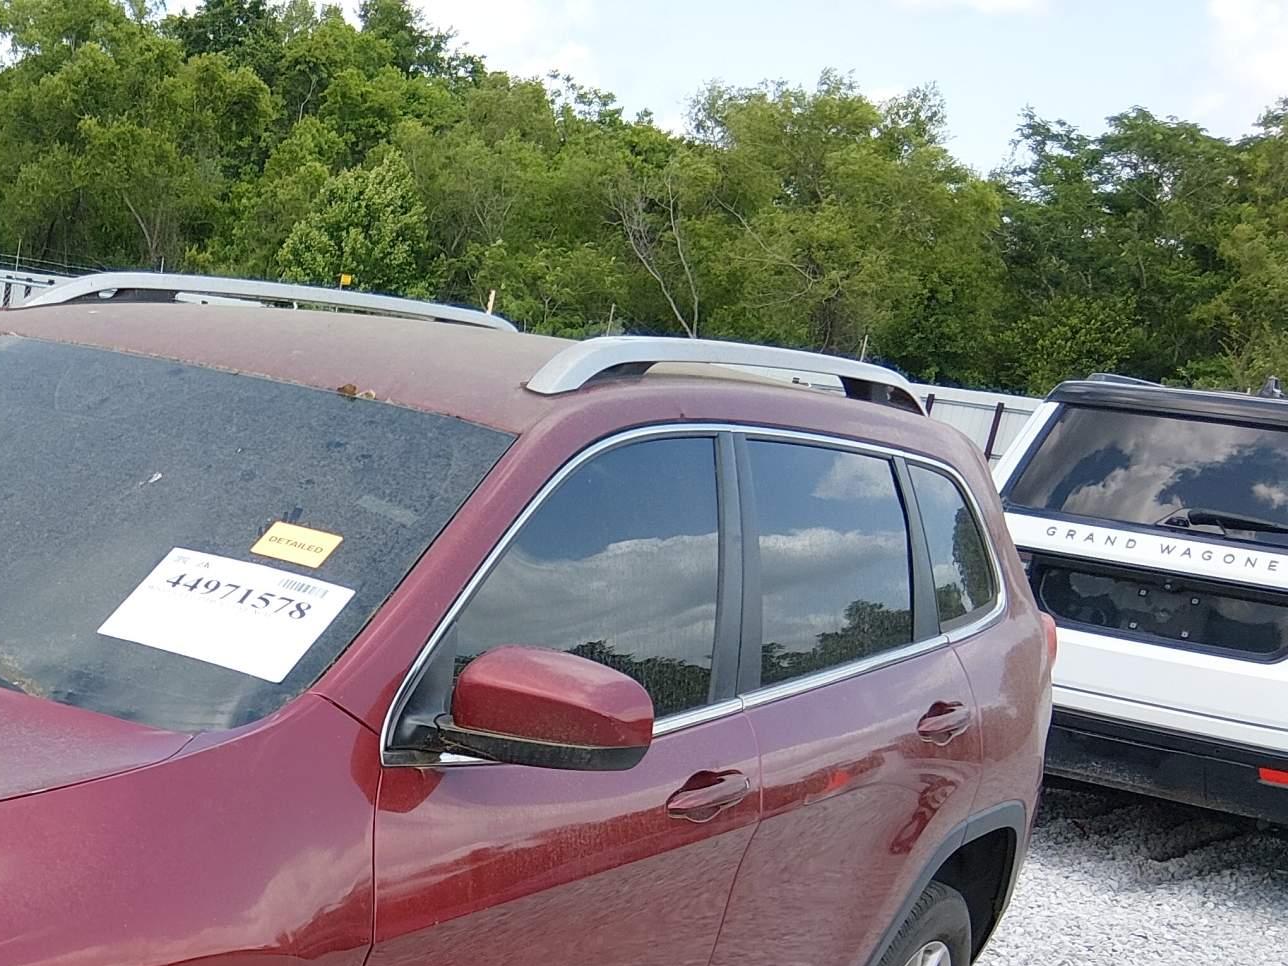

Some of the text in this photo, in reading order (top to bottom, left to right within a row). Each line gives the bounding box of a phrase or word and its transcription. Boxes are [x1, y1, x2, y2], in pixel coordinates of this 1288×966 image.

[268, 535, 324, 554] DETAILED
[1046, 526, 1280, 571] GRAND WAGONE
[166, 573, 312, 620] 44971578
